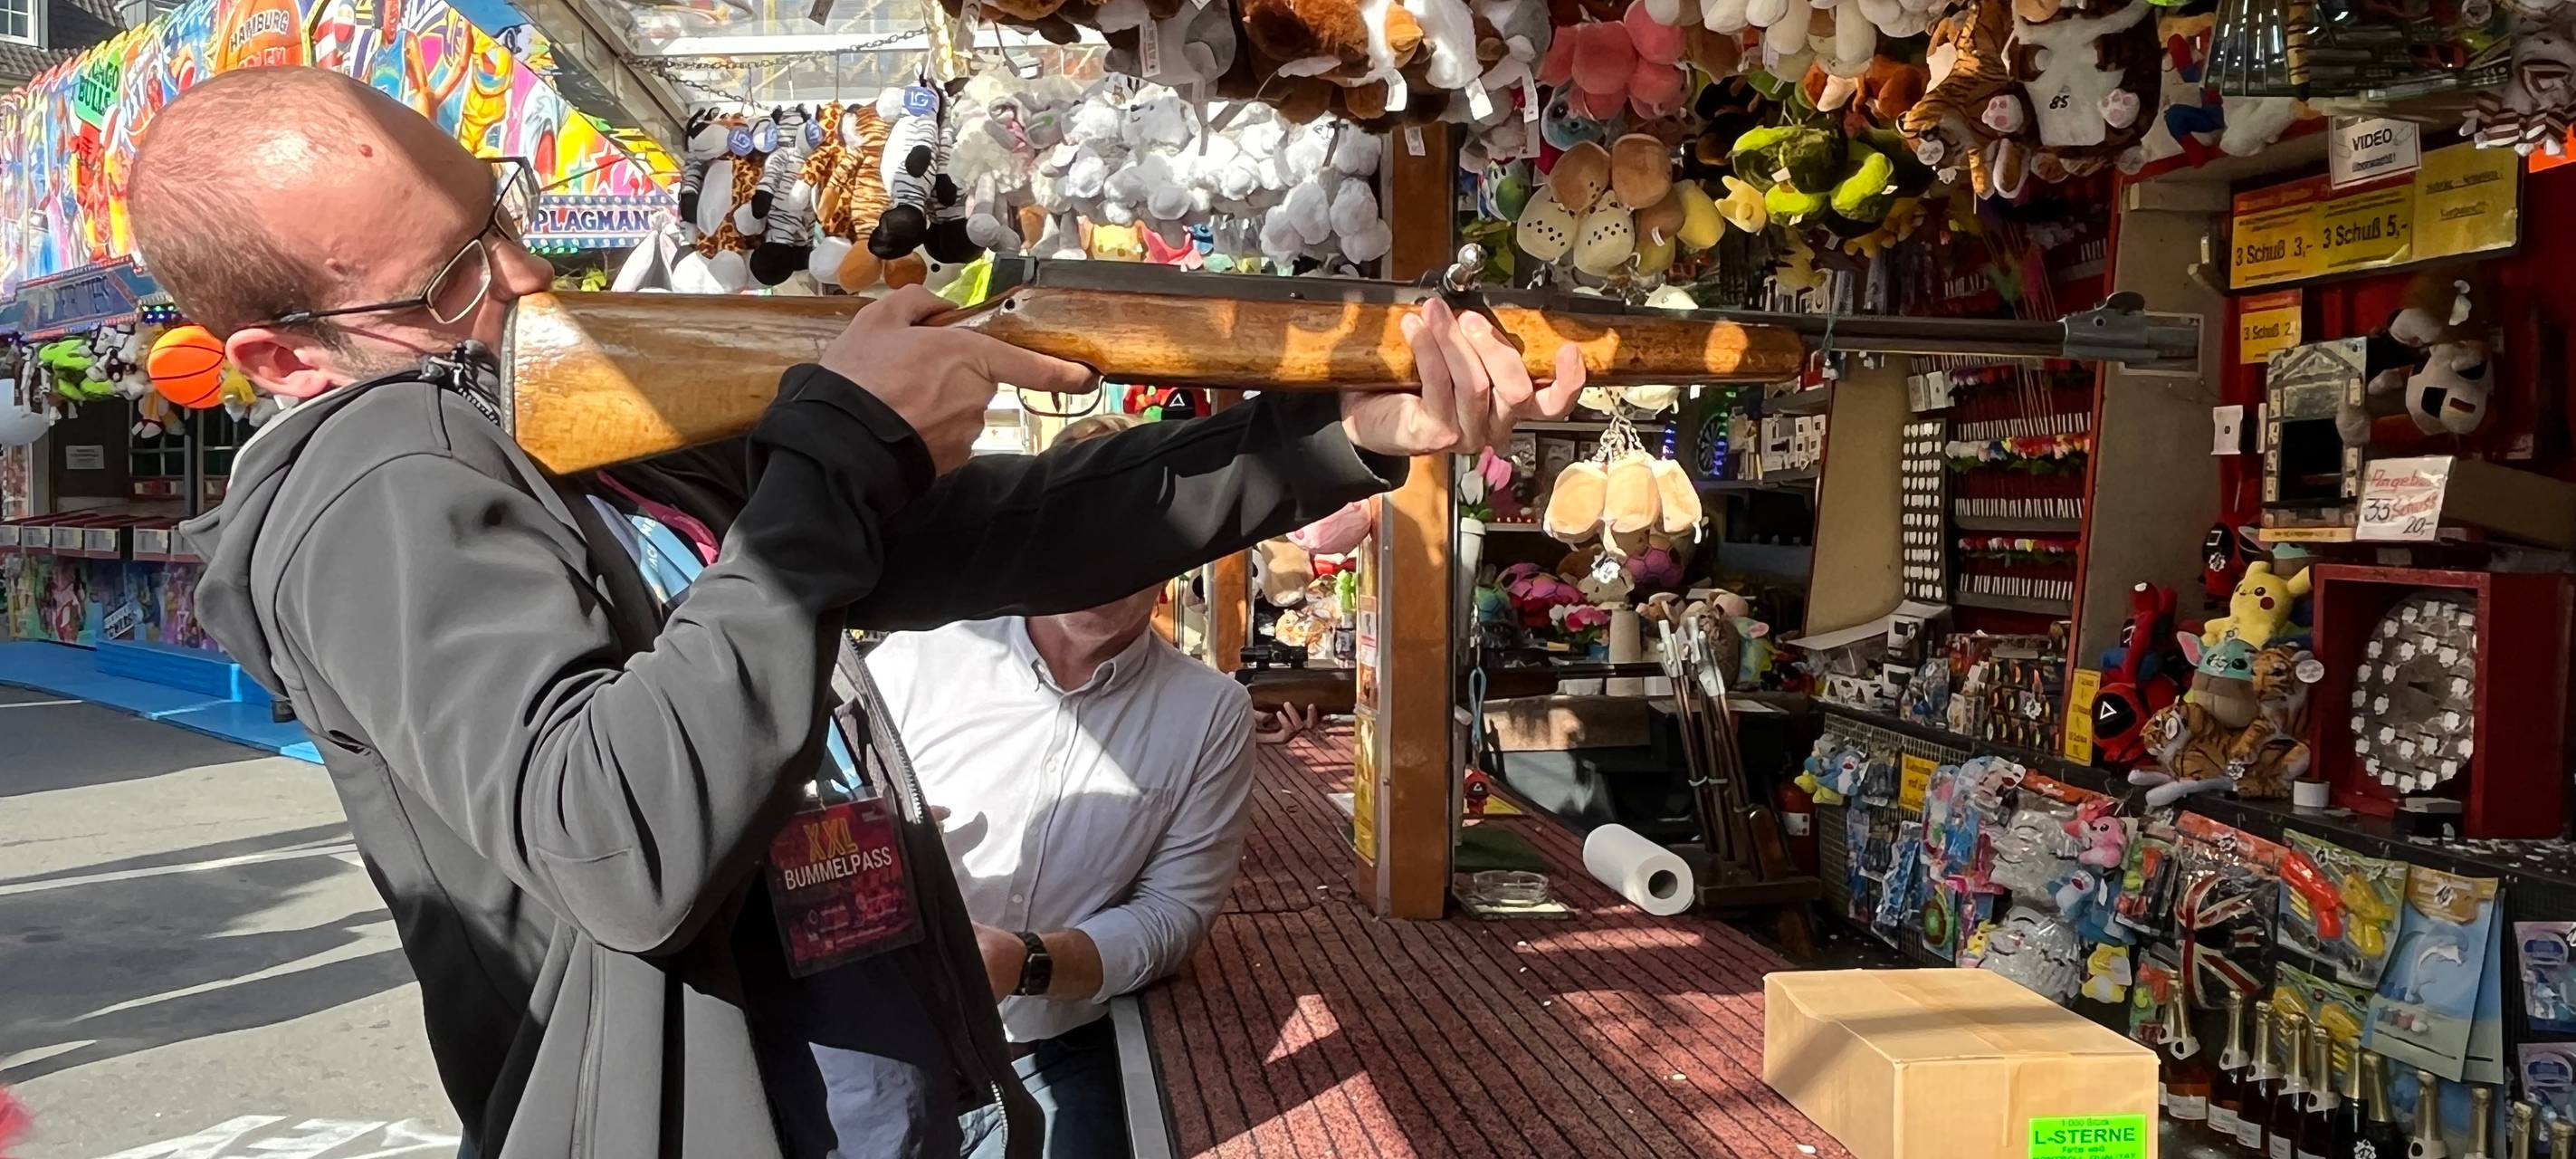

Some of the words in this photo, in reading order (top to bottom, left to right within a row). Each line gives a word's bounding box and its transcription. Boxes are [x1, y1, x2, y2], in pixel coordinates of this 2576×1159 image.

[230, 10, 289, 52] HAMBURG
[2352, 128, 2393, 151] VIDEO
[2322, 227, 2332, 250] 3
[2335, 216, 2381, 247] Schuß
[2386, 214, 2409, 240] 5,-
[2236, 246, 2244, 267] 3
[2247, 239, 2286, 264] Schuß
[2294, 235, 2314, 258] 3,-
[803, 817, 860, 863] XXL
[784, 846, 892, 891] BUMMELPASS
[2035, 1126, 2136, 1145] L-STERNE
